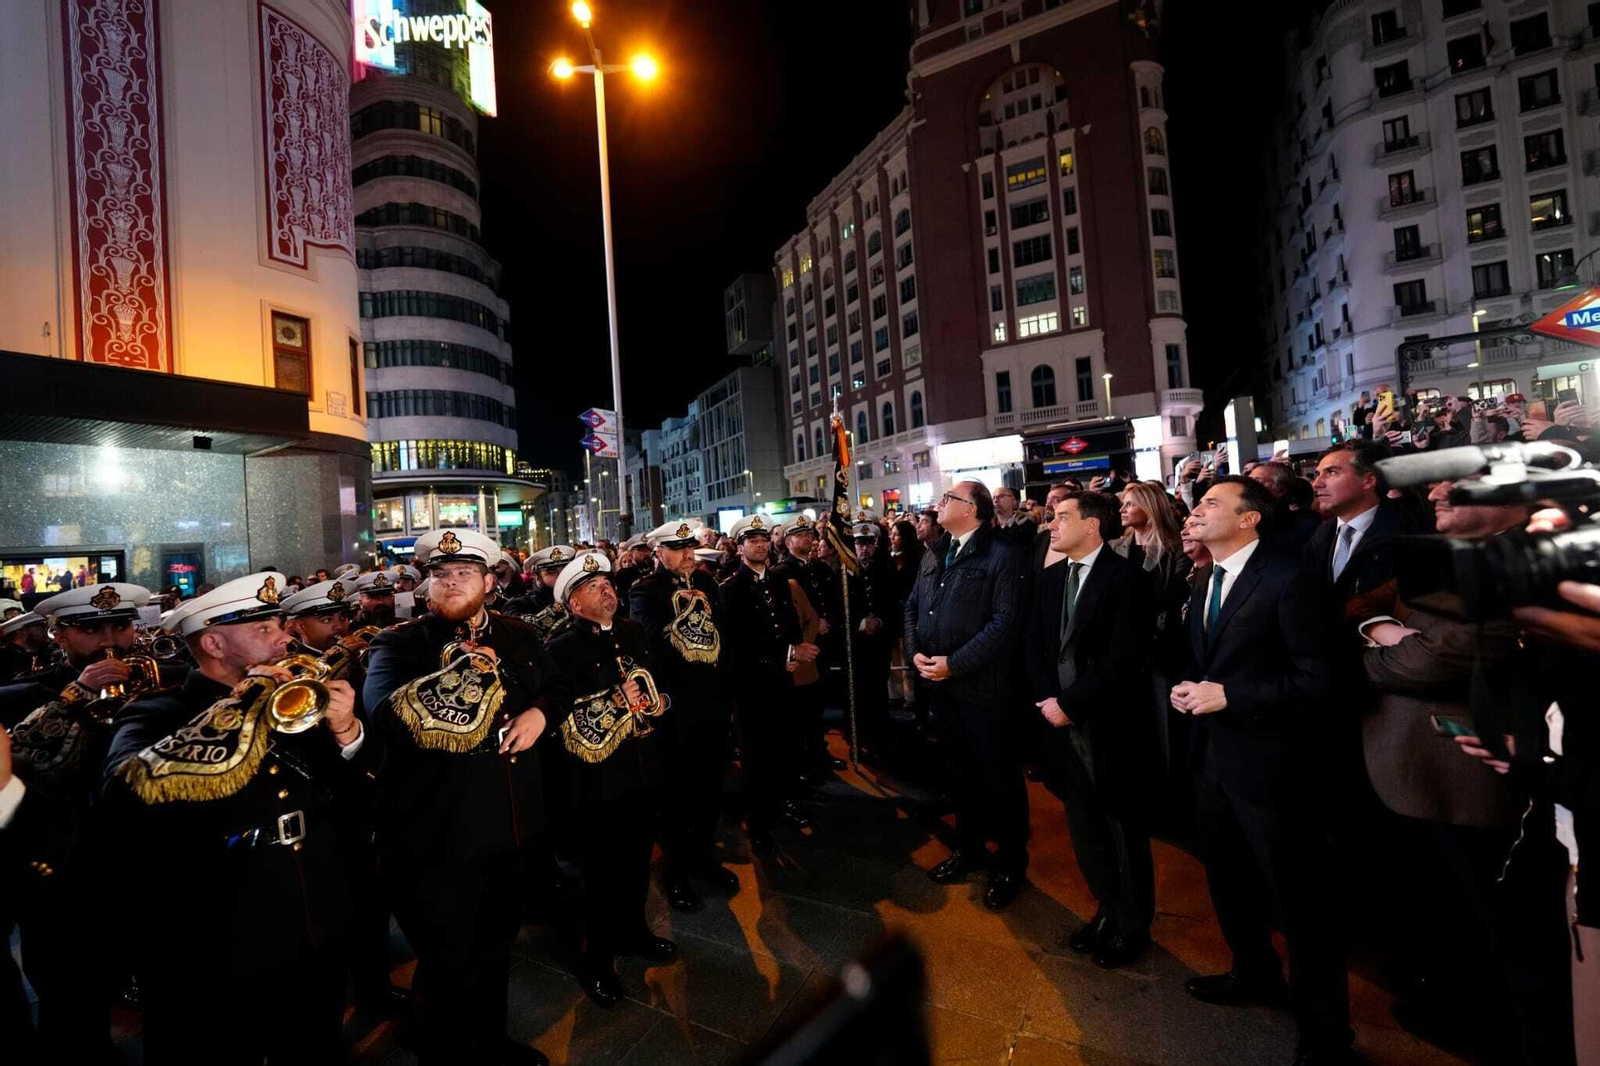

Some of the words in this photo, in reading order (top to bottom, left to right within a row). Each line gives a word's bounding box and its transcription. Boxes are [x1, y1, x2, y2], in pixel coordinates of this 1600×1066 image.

[363, 9, 492, 50] Schweppes
[679, 625, 712, 645] ROSARIO
[418, 688, 470, 725] ROSARIO
[574, 708, 601, 744] ROSARIO
[154, 735, 228, 763] OSARIO
